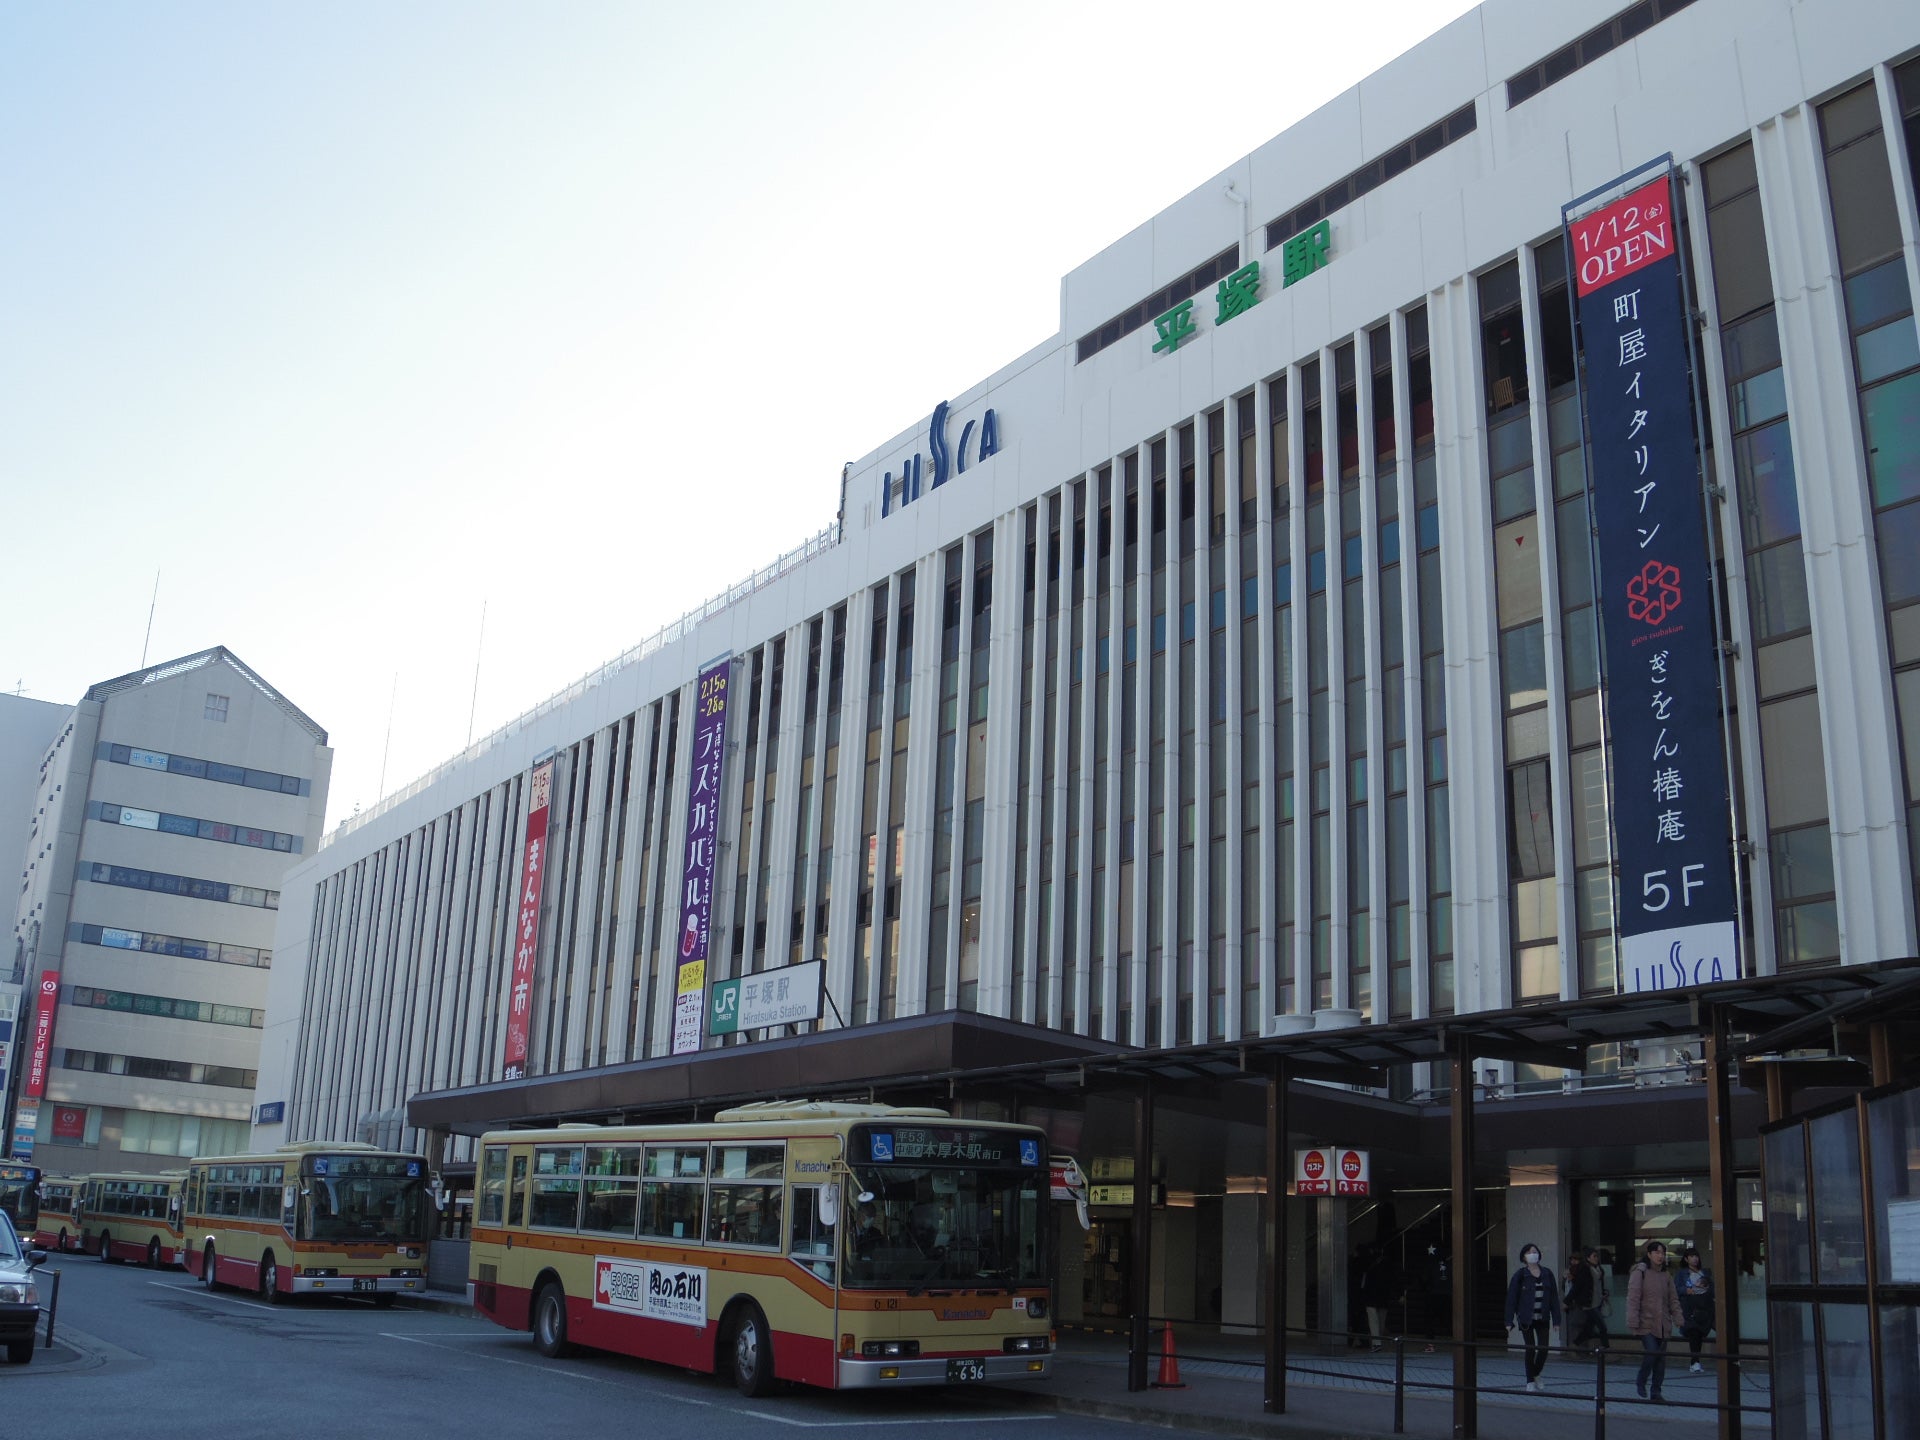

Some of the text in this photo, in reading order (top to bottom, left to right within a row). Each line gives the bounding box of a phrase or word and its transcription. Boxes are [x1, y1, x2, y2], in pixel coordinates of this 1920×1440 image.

[1580, 221, 1666, 285] OPEN
[1151, 219, 1331, 354] 平塚駅
[1613, 289, 1660, 549] 町屋イタリアン
[1648, 649, 1686, 844] ぎをん椿庵
[686, 726, 712, 910] ラスカバル
[1642, 863, 1704, 912] 5F
[514, 839, 539, 1016] まんなか市
[715, 987, 736, 1013] JR
[745, 976, 790, 1008] 平塚駅
[743, 1003, 807, 1025] Hiratsuka Station
[923, 1142, 982, 1160] 本厚木駅
[794, 1159, 831, 1172] Kanachu
[1306, 1163, 1323, 1171] ガスト
[1343, 1163, 1360, 1171] ガスト
[1300, 1183, 1312, 1192] すぐ
[1353, 1183, 1365, 1192] すぐ
[610, 1284, 639, 1302] PLAZA
[649, 1268, 702, 1301] 肉の石川
[943, 1308, 987, 1320] Kanachu
